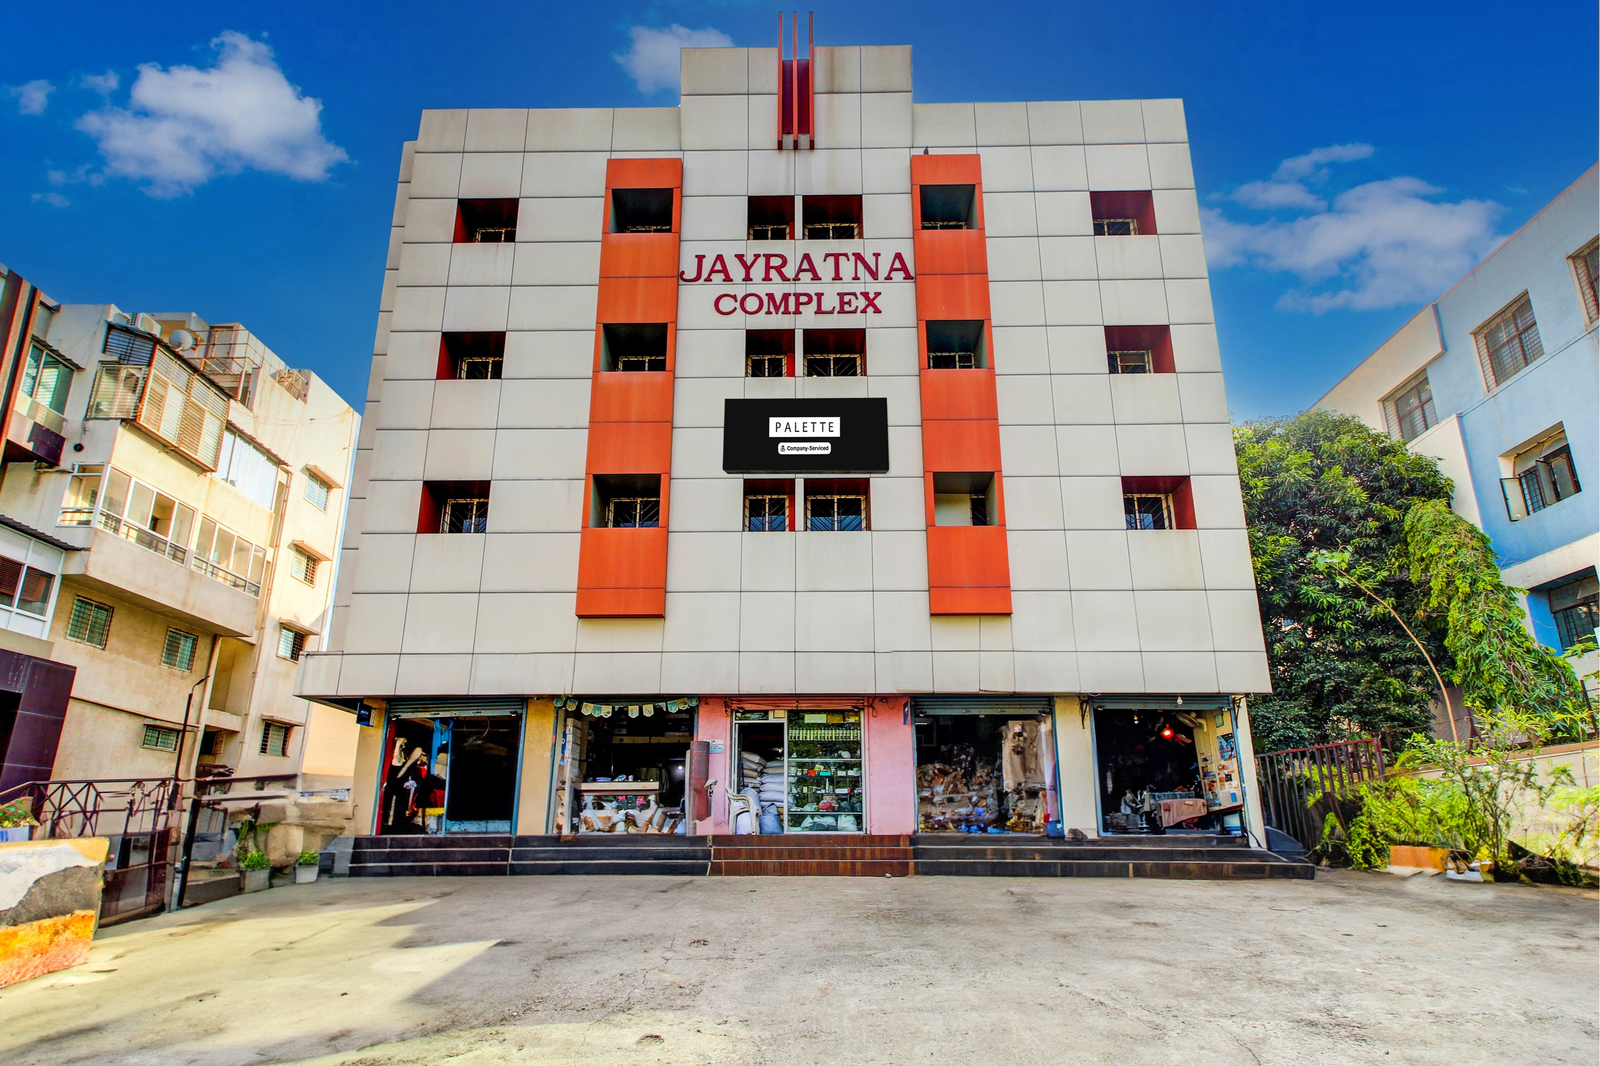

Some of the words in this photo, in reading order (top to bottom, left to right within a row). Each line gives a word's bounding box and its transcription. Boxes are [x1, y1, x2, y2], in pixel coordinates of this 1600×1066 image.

[679, 252, 914, 282] JAYRATNA
[714, 291, 882, 315] COMPLEX
[775, 421, 834, 433] PALETTE
